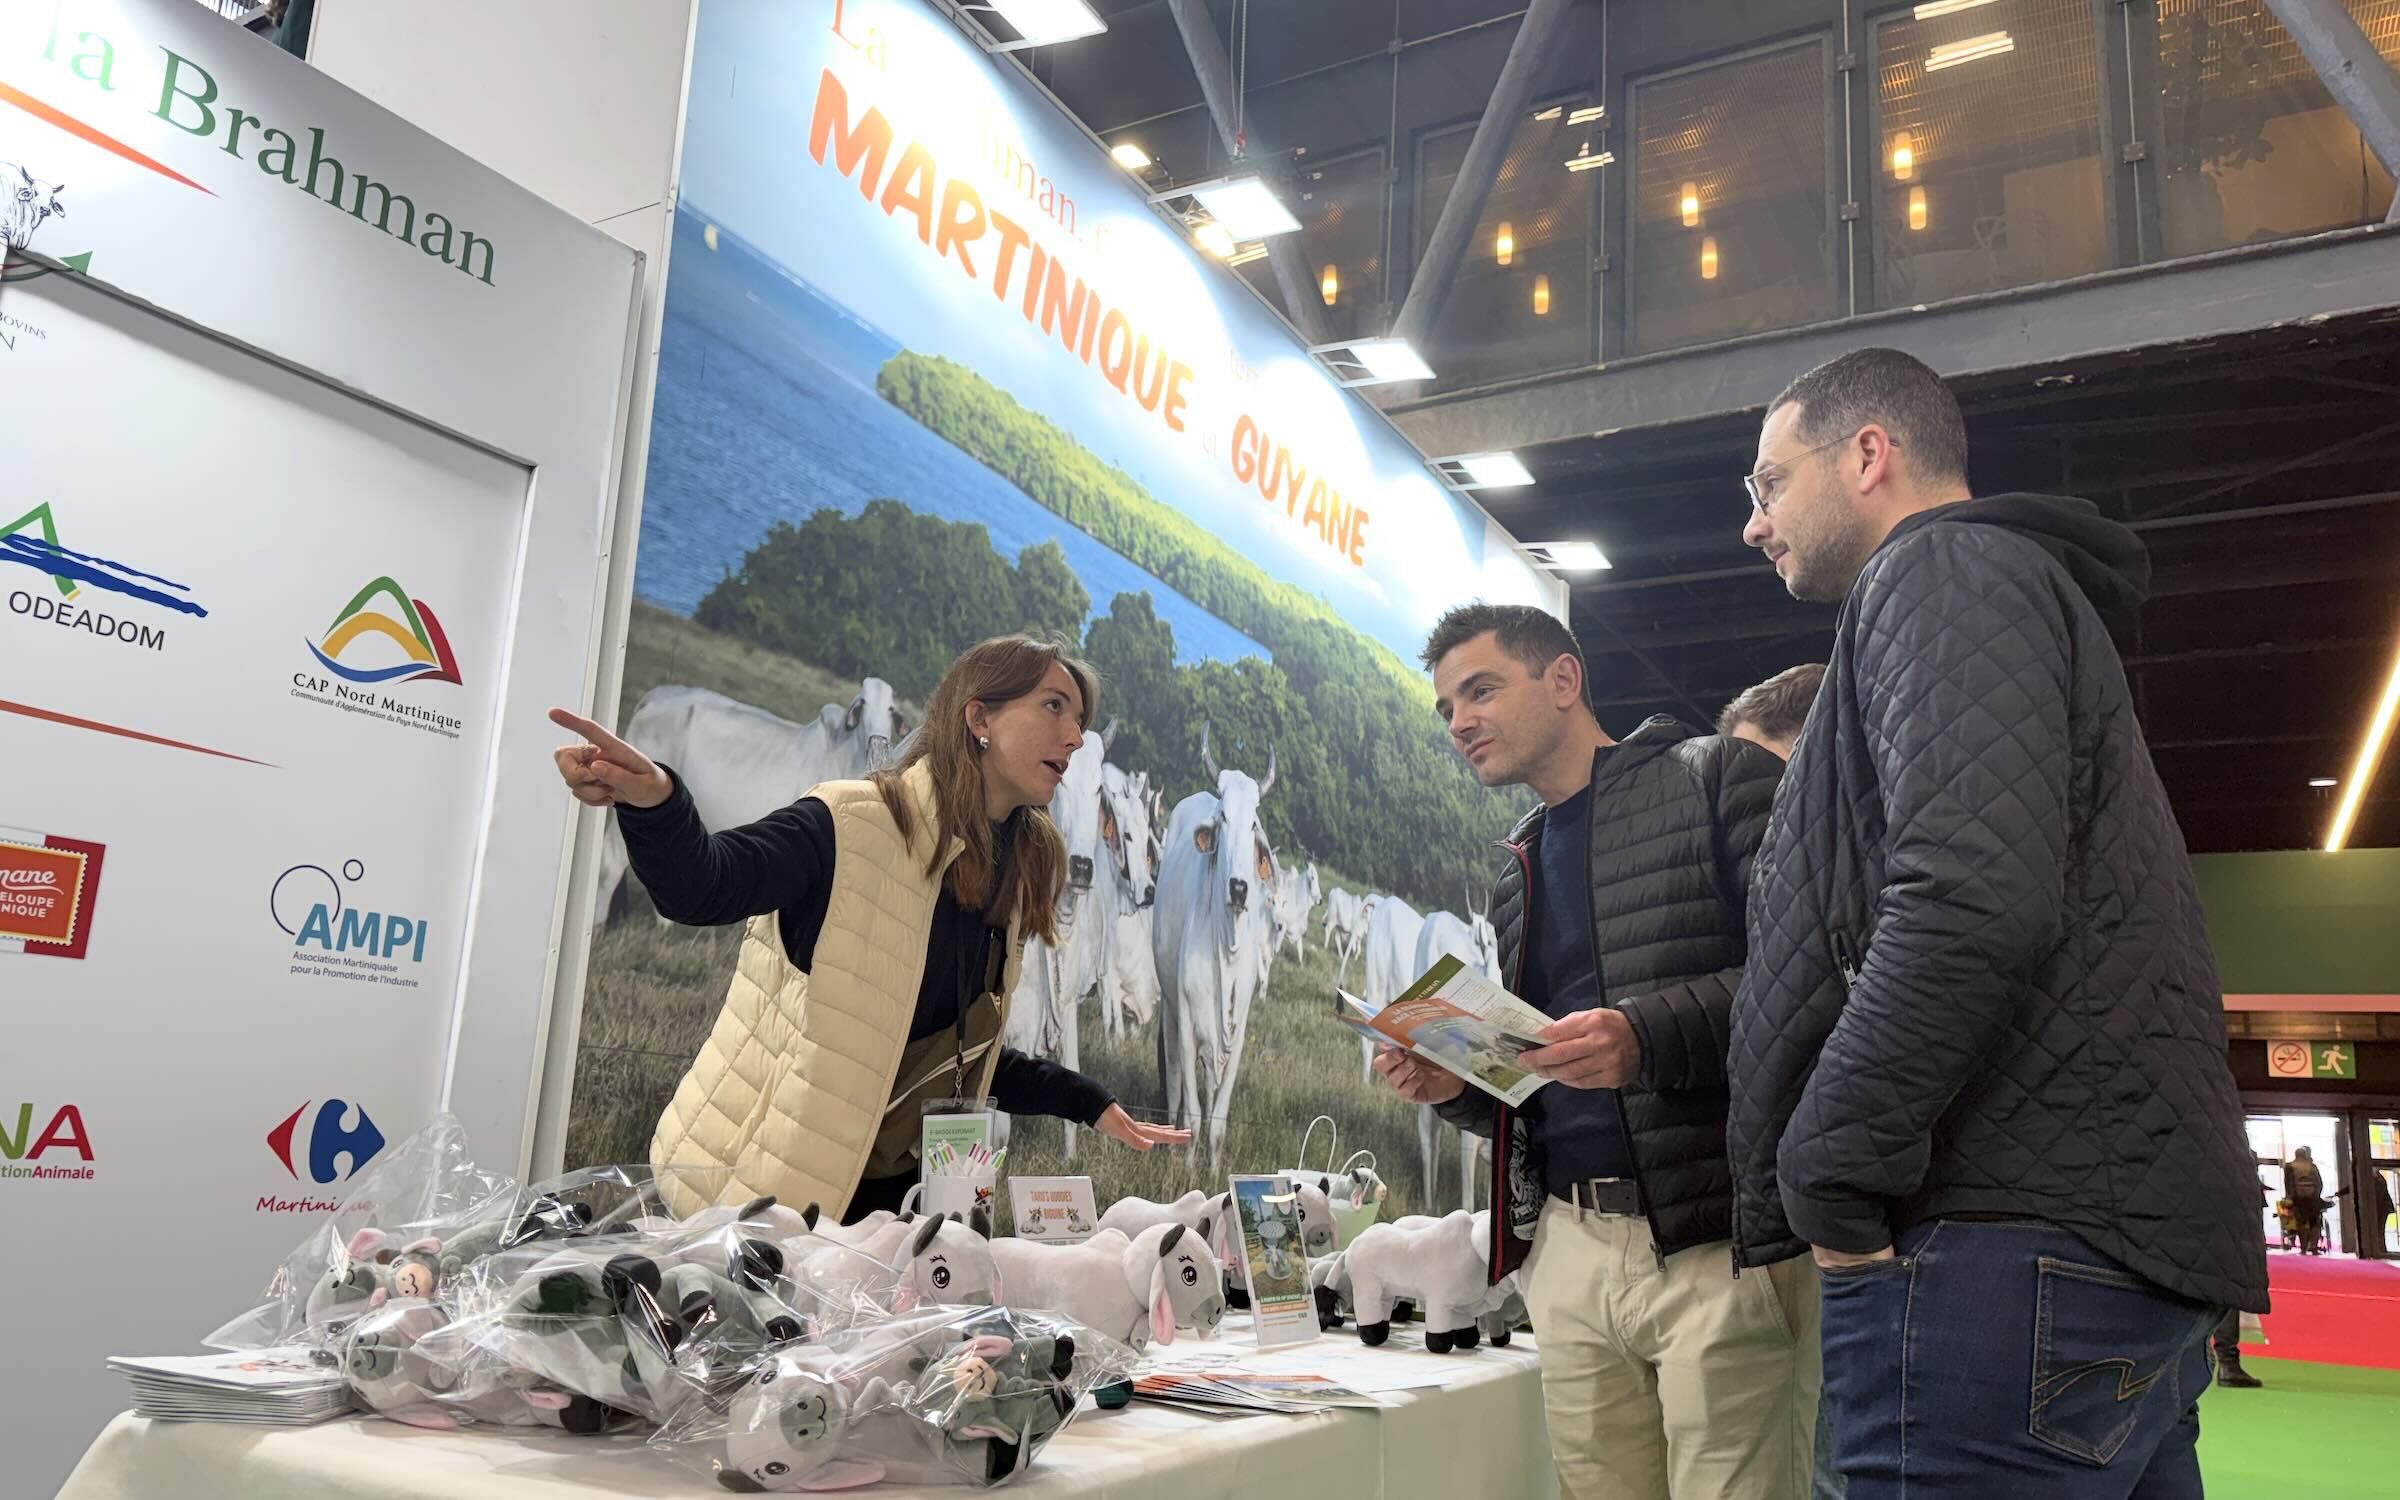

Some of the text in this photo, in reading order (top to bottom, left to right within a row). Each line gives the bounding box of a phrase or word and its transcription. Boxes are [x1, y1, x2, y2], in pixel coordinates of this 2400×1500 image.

[147, 45, 497, 288] Brahman
[808, 67, 1195, 433] MARTINIQUE
[1231, 413, 1370, 567] GUYANE
[9, 591, 166, 651] ODEADOM
[293, 673, 462, 729] CAP Nord Martinique
[292, 951, 399, 973] Association Martiniquaise
[295, 903, 428, 963] AMPI
[290, 964, 419, 988] pour la Promotion de l'Industrie
